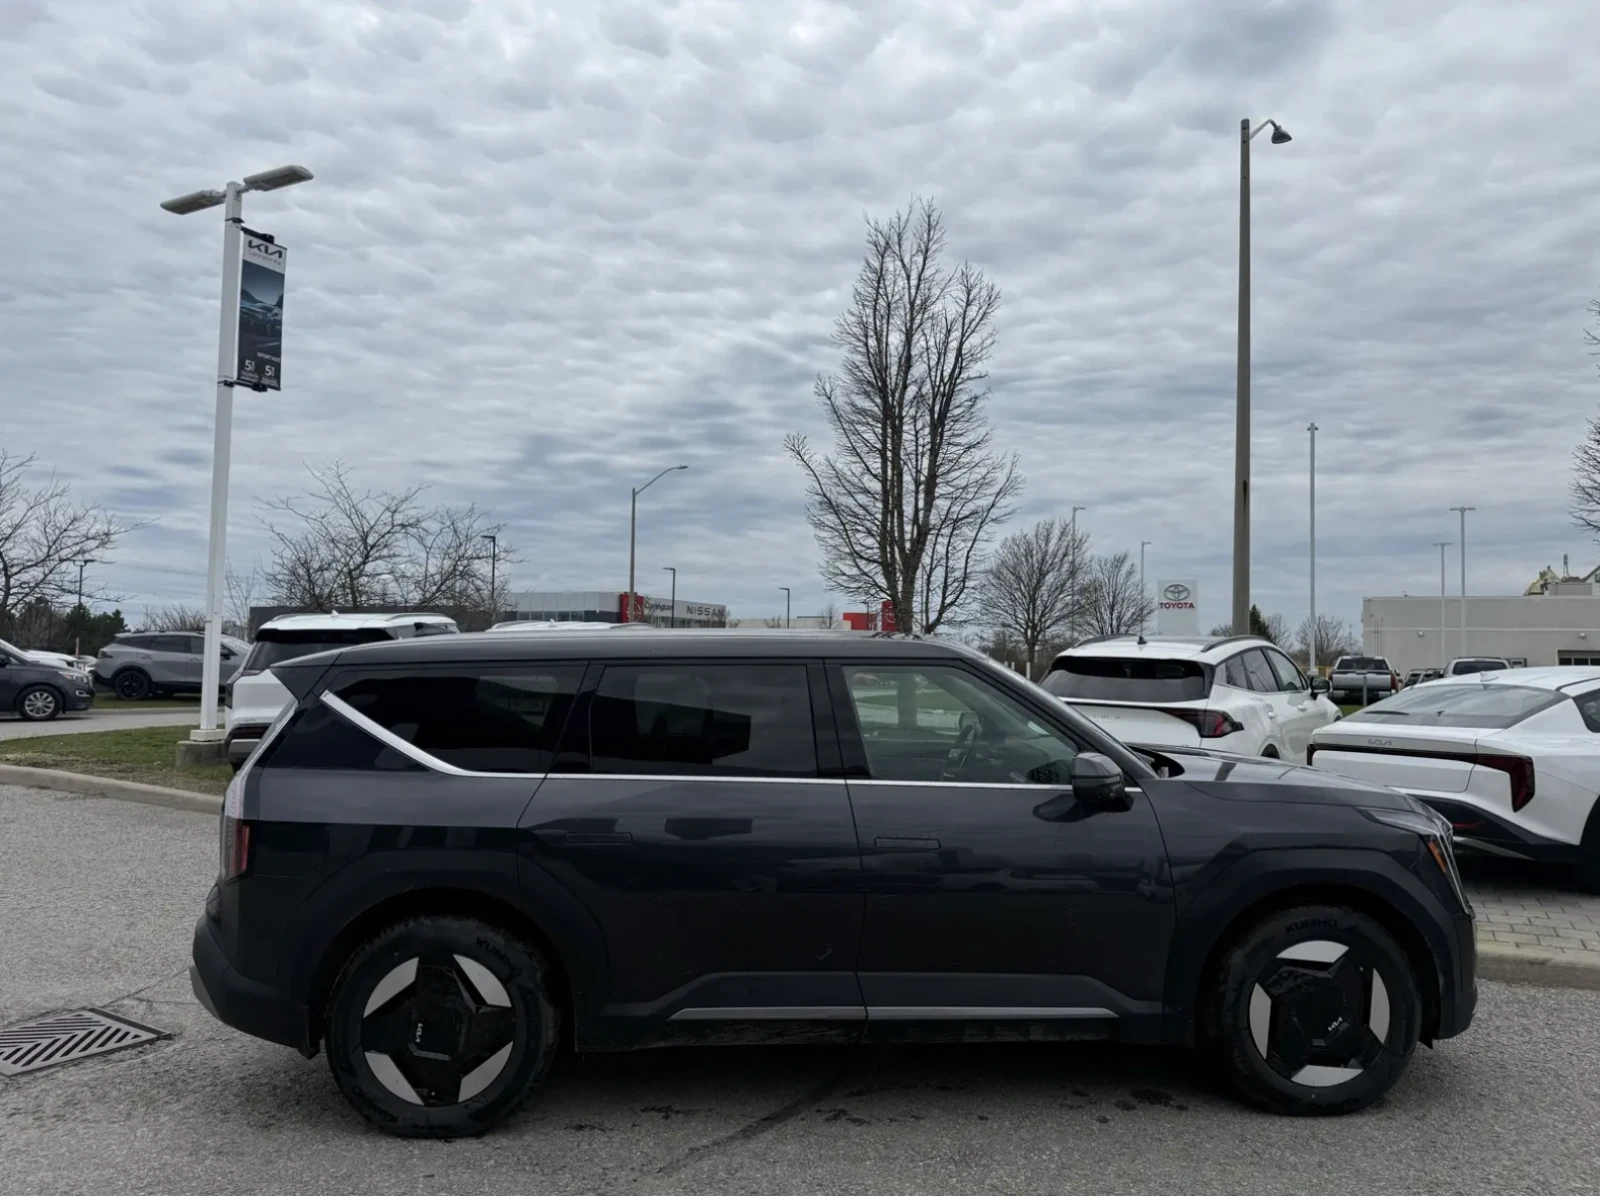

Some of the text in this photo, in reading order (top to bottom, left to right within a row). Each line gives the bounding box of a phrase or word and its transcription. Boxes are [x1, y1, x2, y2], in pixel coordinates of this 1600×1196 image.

[248, 239, 283, 259] KIA
[686, 605, 726, 617] NISSAN
[1368, 738, 1392, 746] KIA
